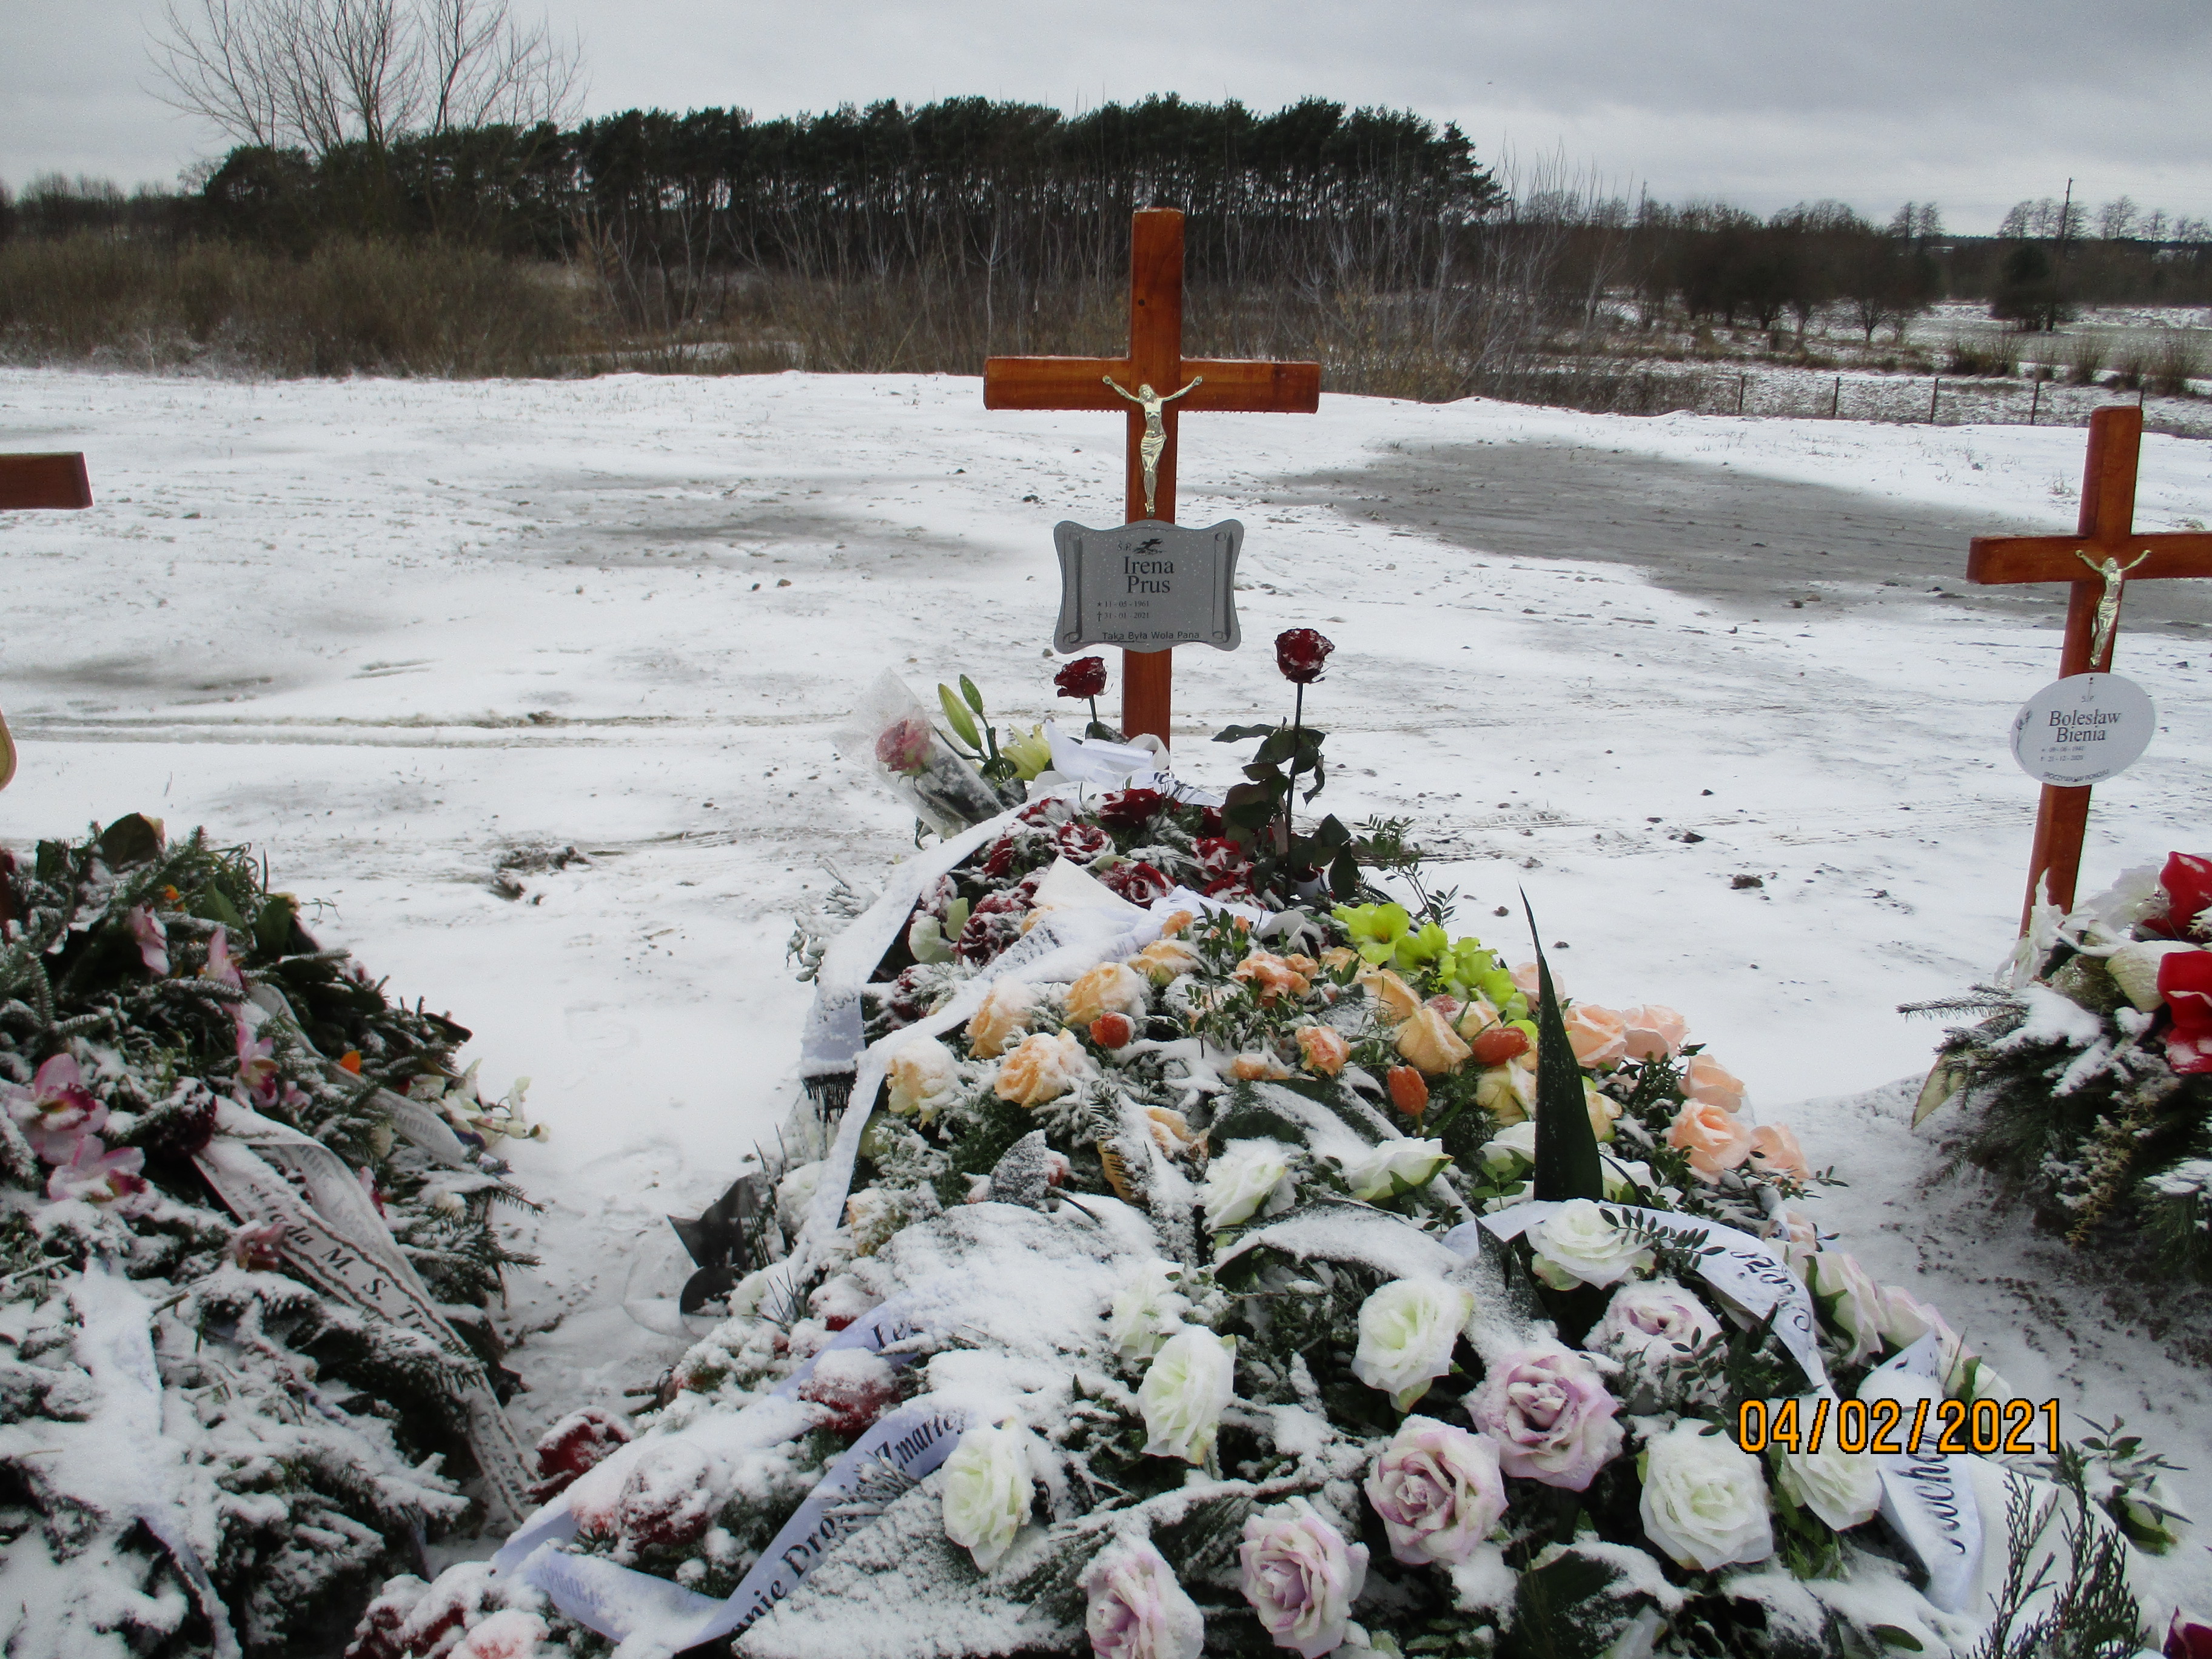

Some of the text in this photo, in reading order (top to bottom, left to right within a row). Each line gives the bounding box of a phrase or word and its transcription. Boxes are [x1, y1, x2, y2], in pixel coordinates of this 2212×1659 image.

[1124, 555, 1175, 575] Irena
[1127, 575, 1170, 594] Prus
[1102, 632, 1124, 640] Taka
[1128, 631, 1148, 641] Była
[2048, 708, 2122, 726] Bolesław
[2054, 725, 2106, 743] Bienia
[320, 1247, 357, 1276] M.
[361, 1277, 389, 1301] S.
